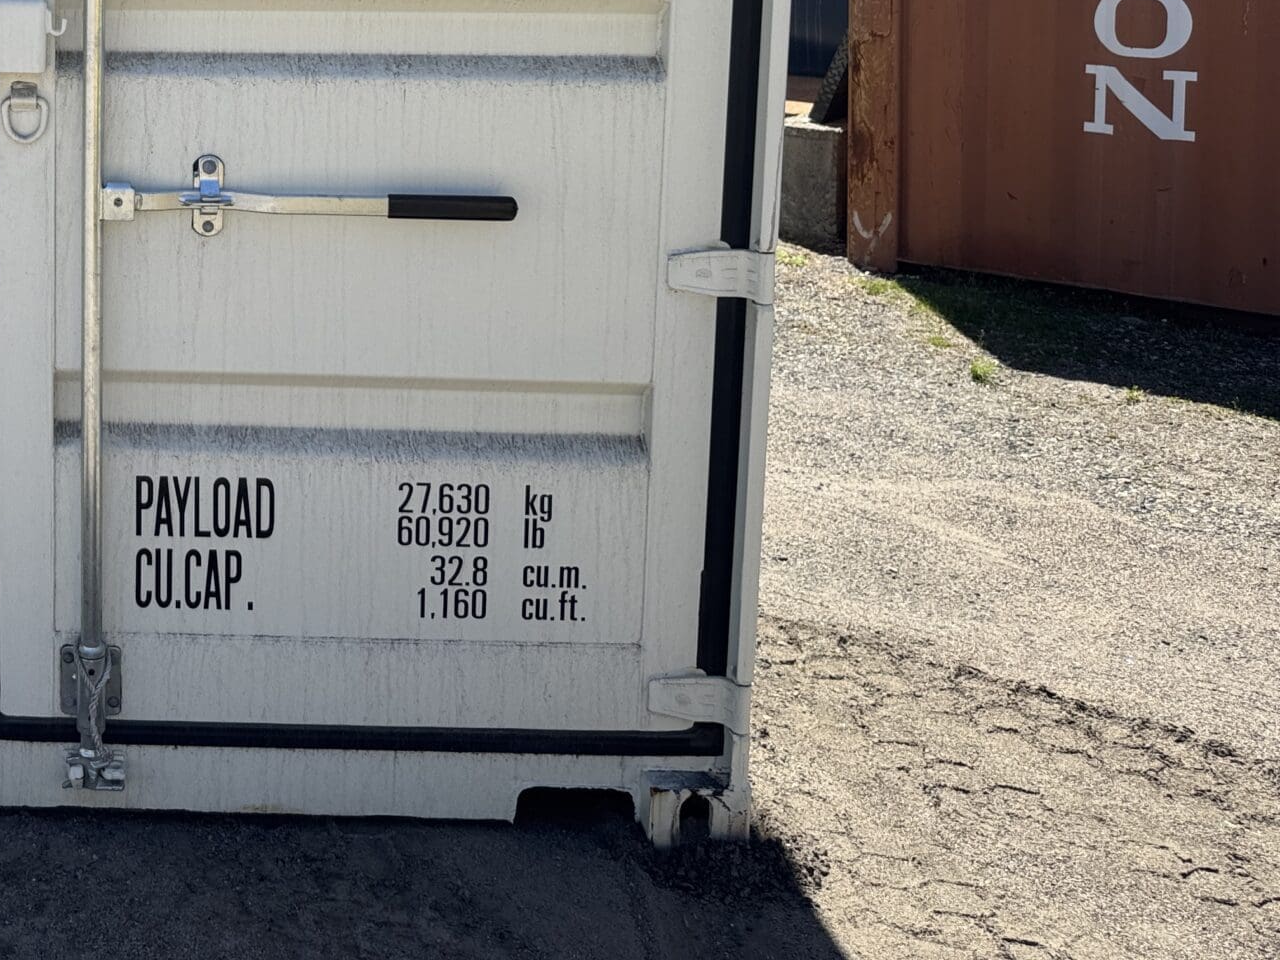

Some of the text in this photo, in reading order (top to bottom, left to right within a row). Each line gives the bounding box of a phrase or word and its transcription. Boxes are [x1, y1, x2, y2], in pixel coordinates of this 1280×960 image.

[135, 475, 275, 539] PAYLOAD
[397, 482, 553, 522] 27,630 kg
[396, 516, 545, 549] 60,920 lb
[430, 555, 588, 589] 32.8 cu.m.
[418, 588, 587, 622] 1,160 cu.ft.
